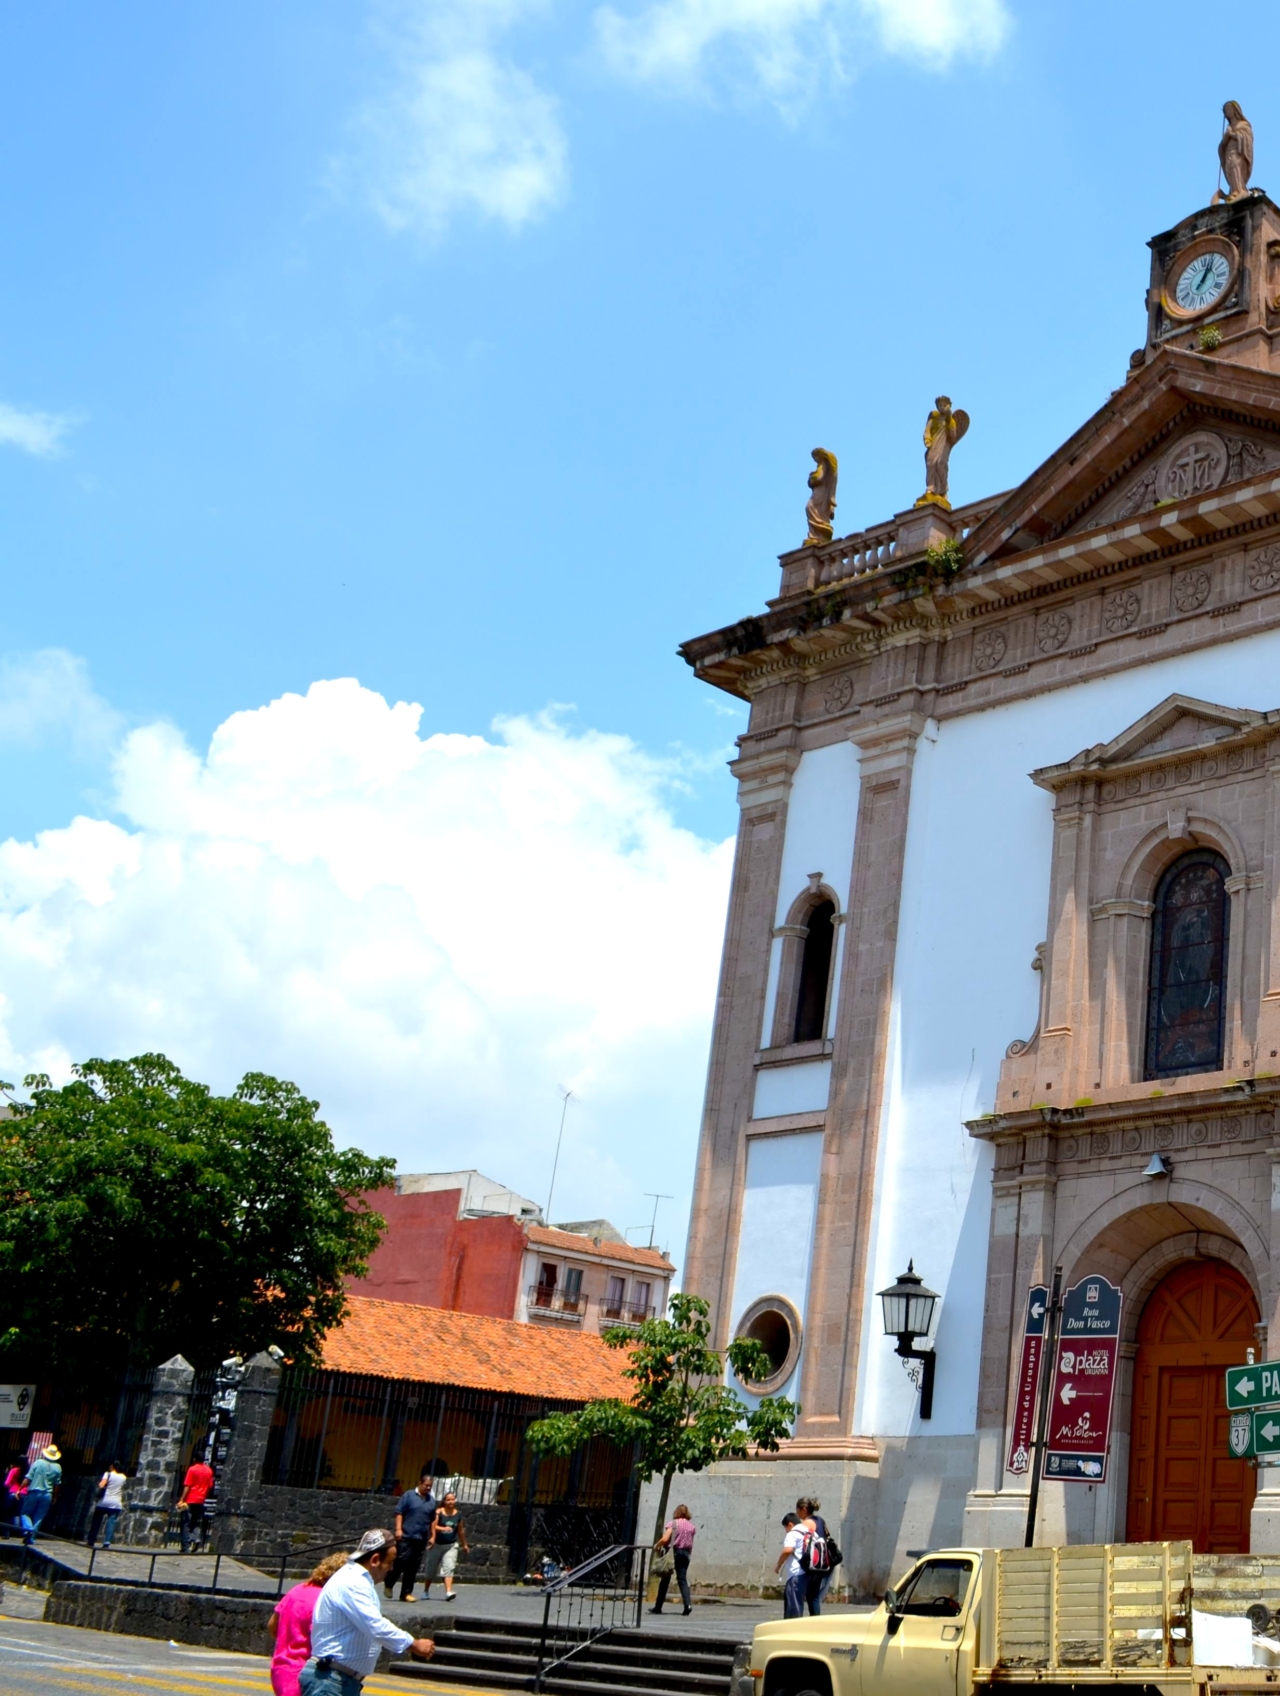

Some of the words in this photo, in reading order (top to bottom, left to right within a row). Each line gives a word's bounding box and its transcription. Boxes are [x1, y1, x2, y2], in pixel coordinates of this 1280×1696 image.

[1082, 1307, 1099, 1317] Ruta
[1067, 1318, 1085, 1329] Don
[1087, 1317, 1111, 1329] Vasco
[1024, 1340, 1036, 1391] Uruapan
[1075, 1350, 1109, 1375] plaza
[1023, 1395, 1031, 1408] de
[1233, 1417, 1248, 1425] MEXICO
[1234, 1428, 1247, 1447] 37
